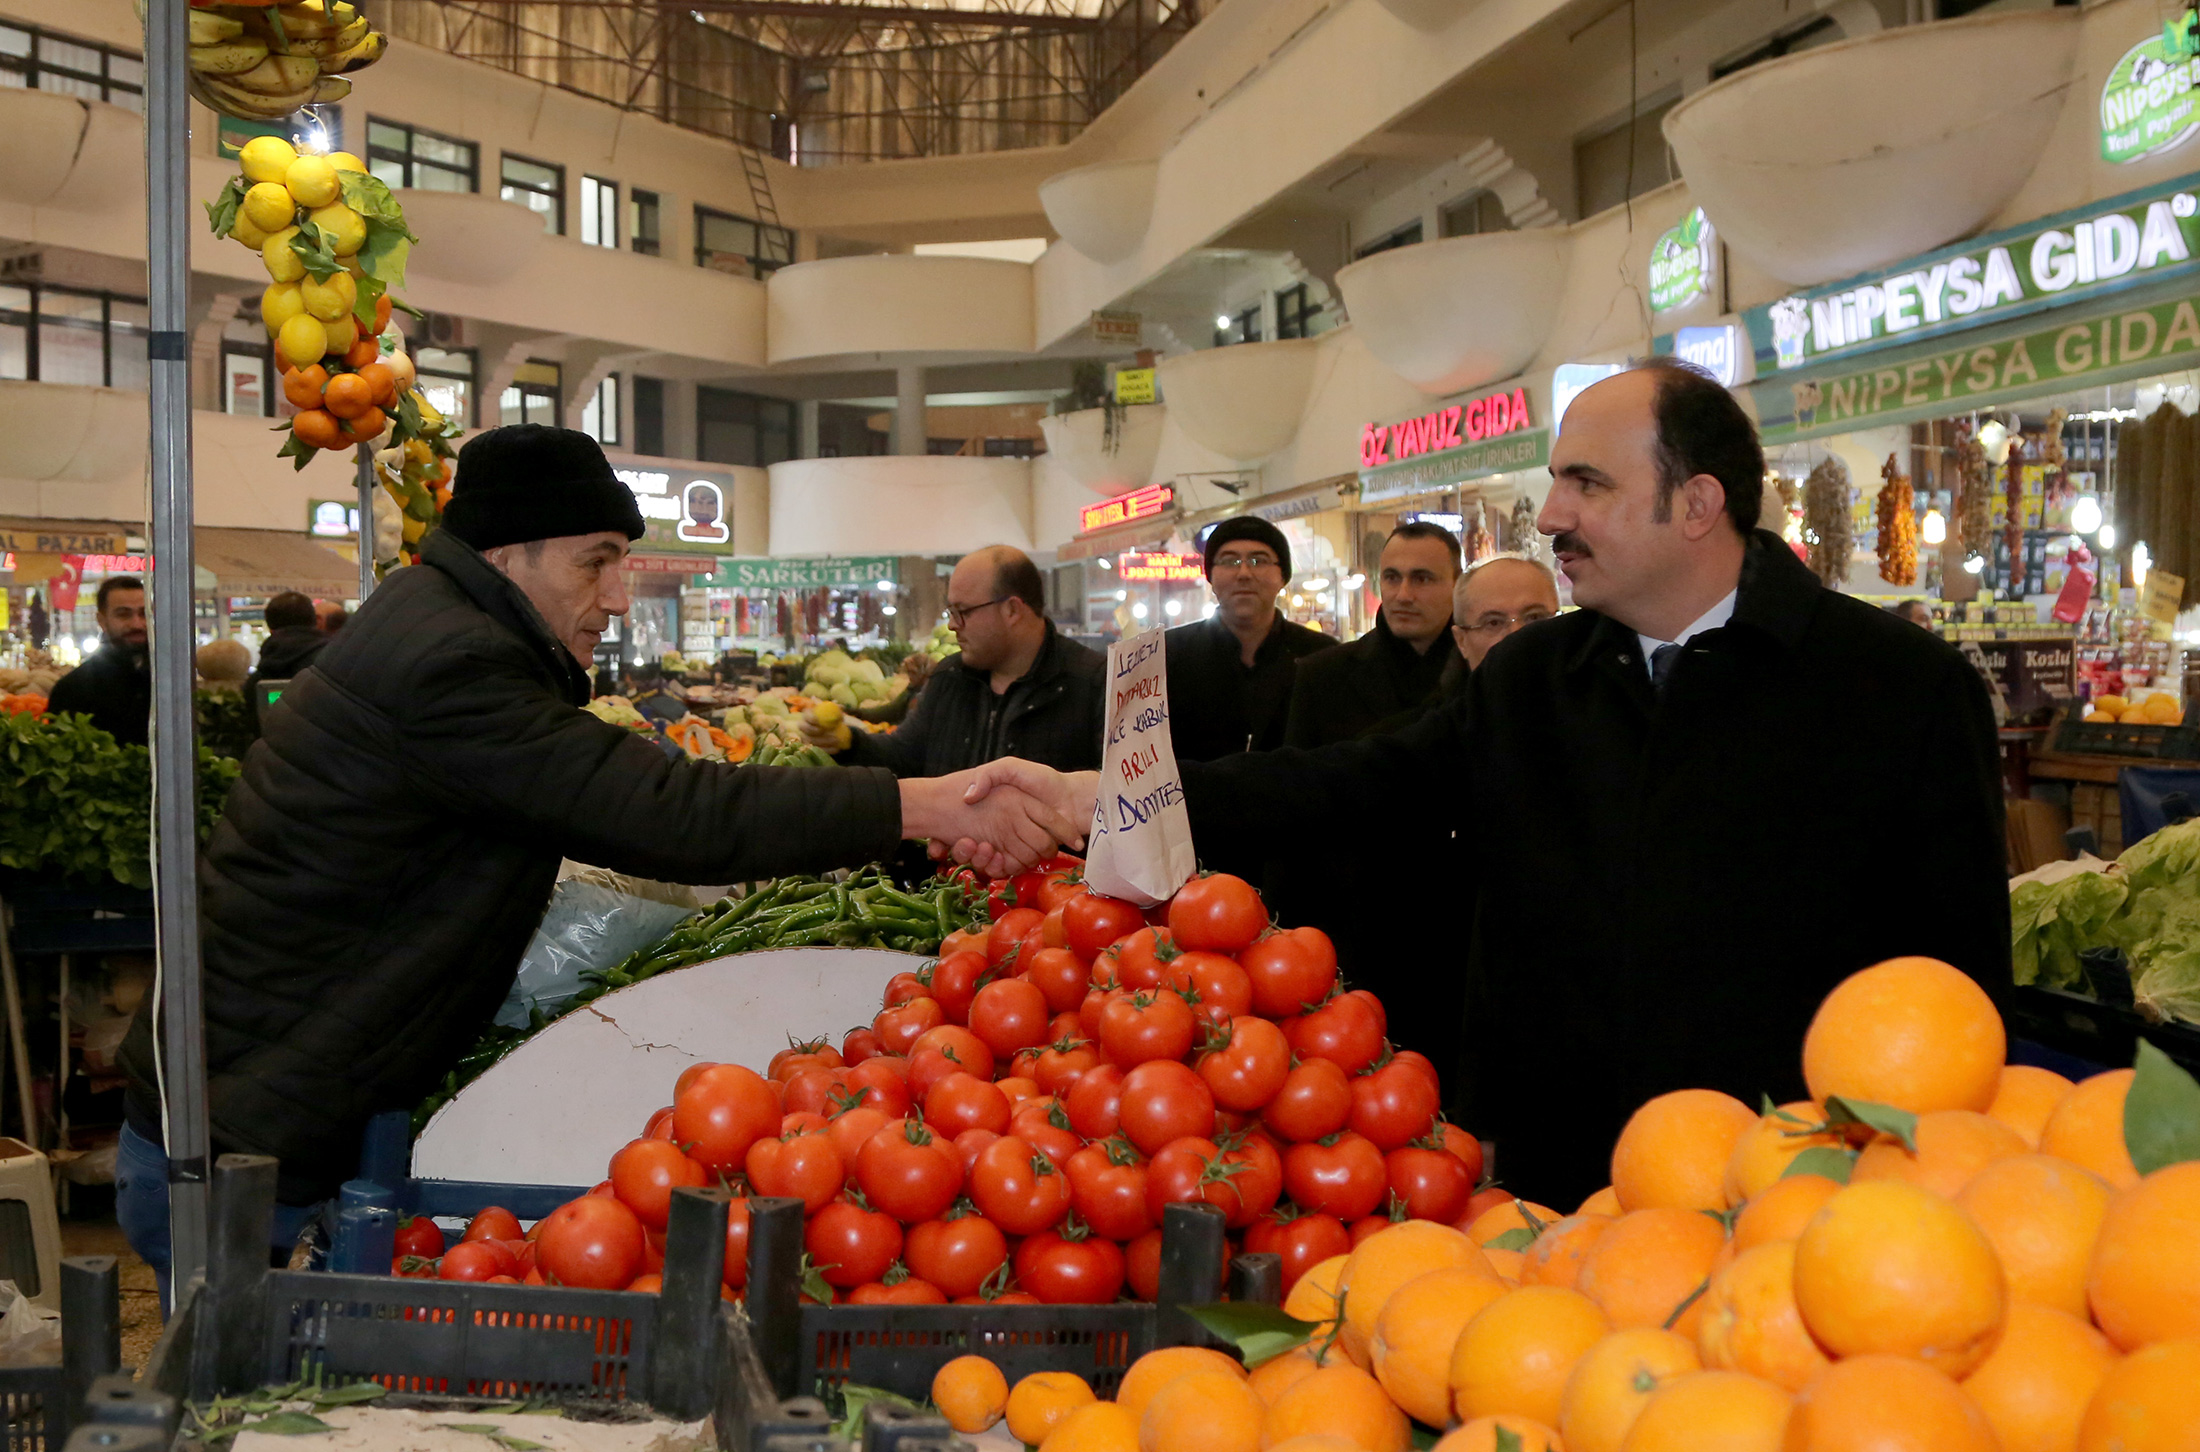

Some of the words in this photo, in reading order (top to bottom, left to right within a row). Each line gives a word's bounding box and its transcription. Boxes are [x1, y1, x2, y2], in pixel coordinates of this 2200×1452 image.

[2030, 201, 2190, 292] GIDA
[2055, 301, 2200, 373] GIDA
[1360, 422, 1390, 468] ÖZ
[1390, 405, 1463, 460] YAVUZ
[1465, 387, 1530, 441] GIDA
[1263, 495, 1321, 520] PAZARI
[37, 535, 115, 552] PAZARI
[738, 560, 893, 585] ŞARKÜTERİ
[2026, 649, 2071, 668] Kozlu
